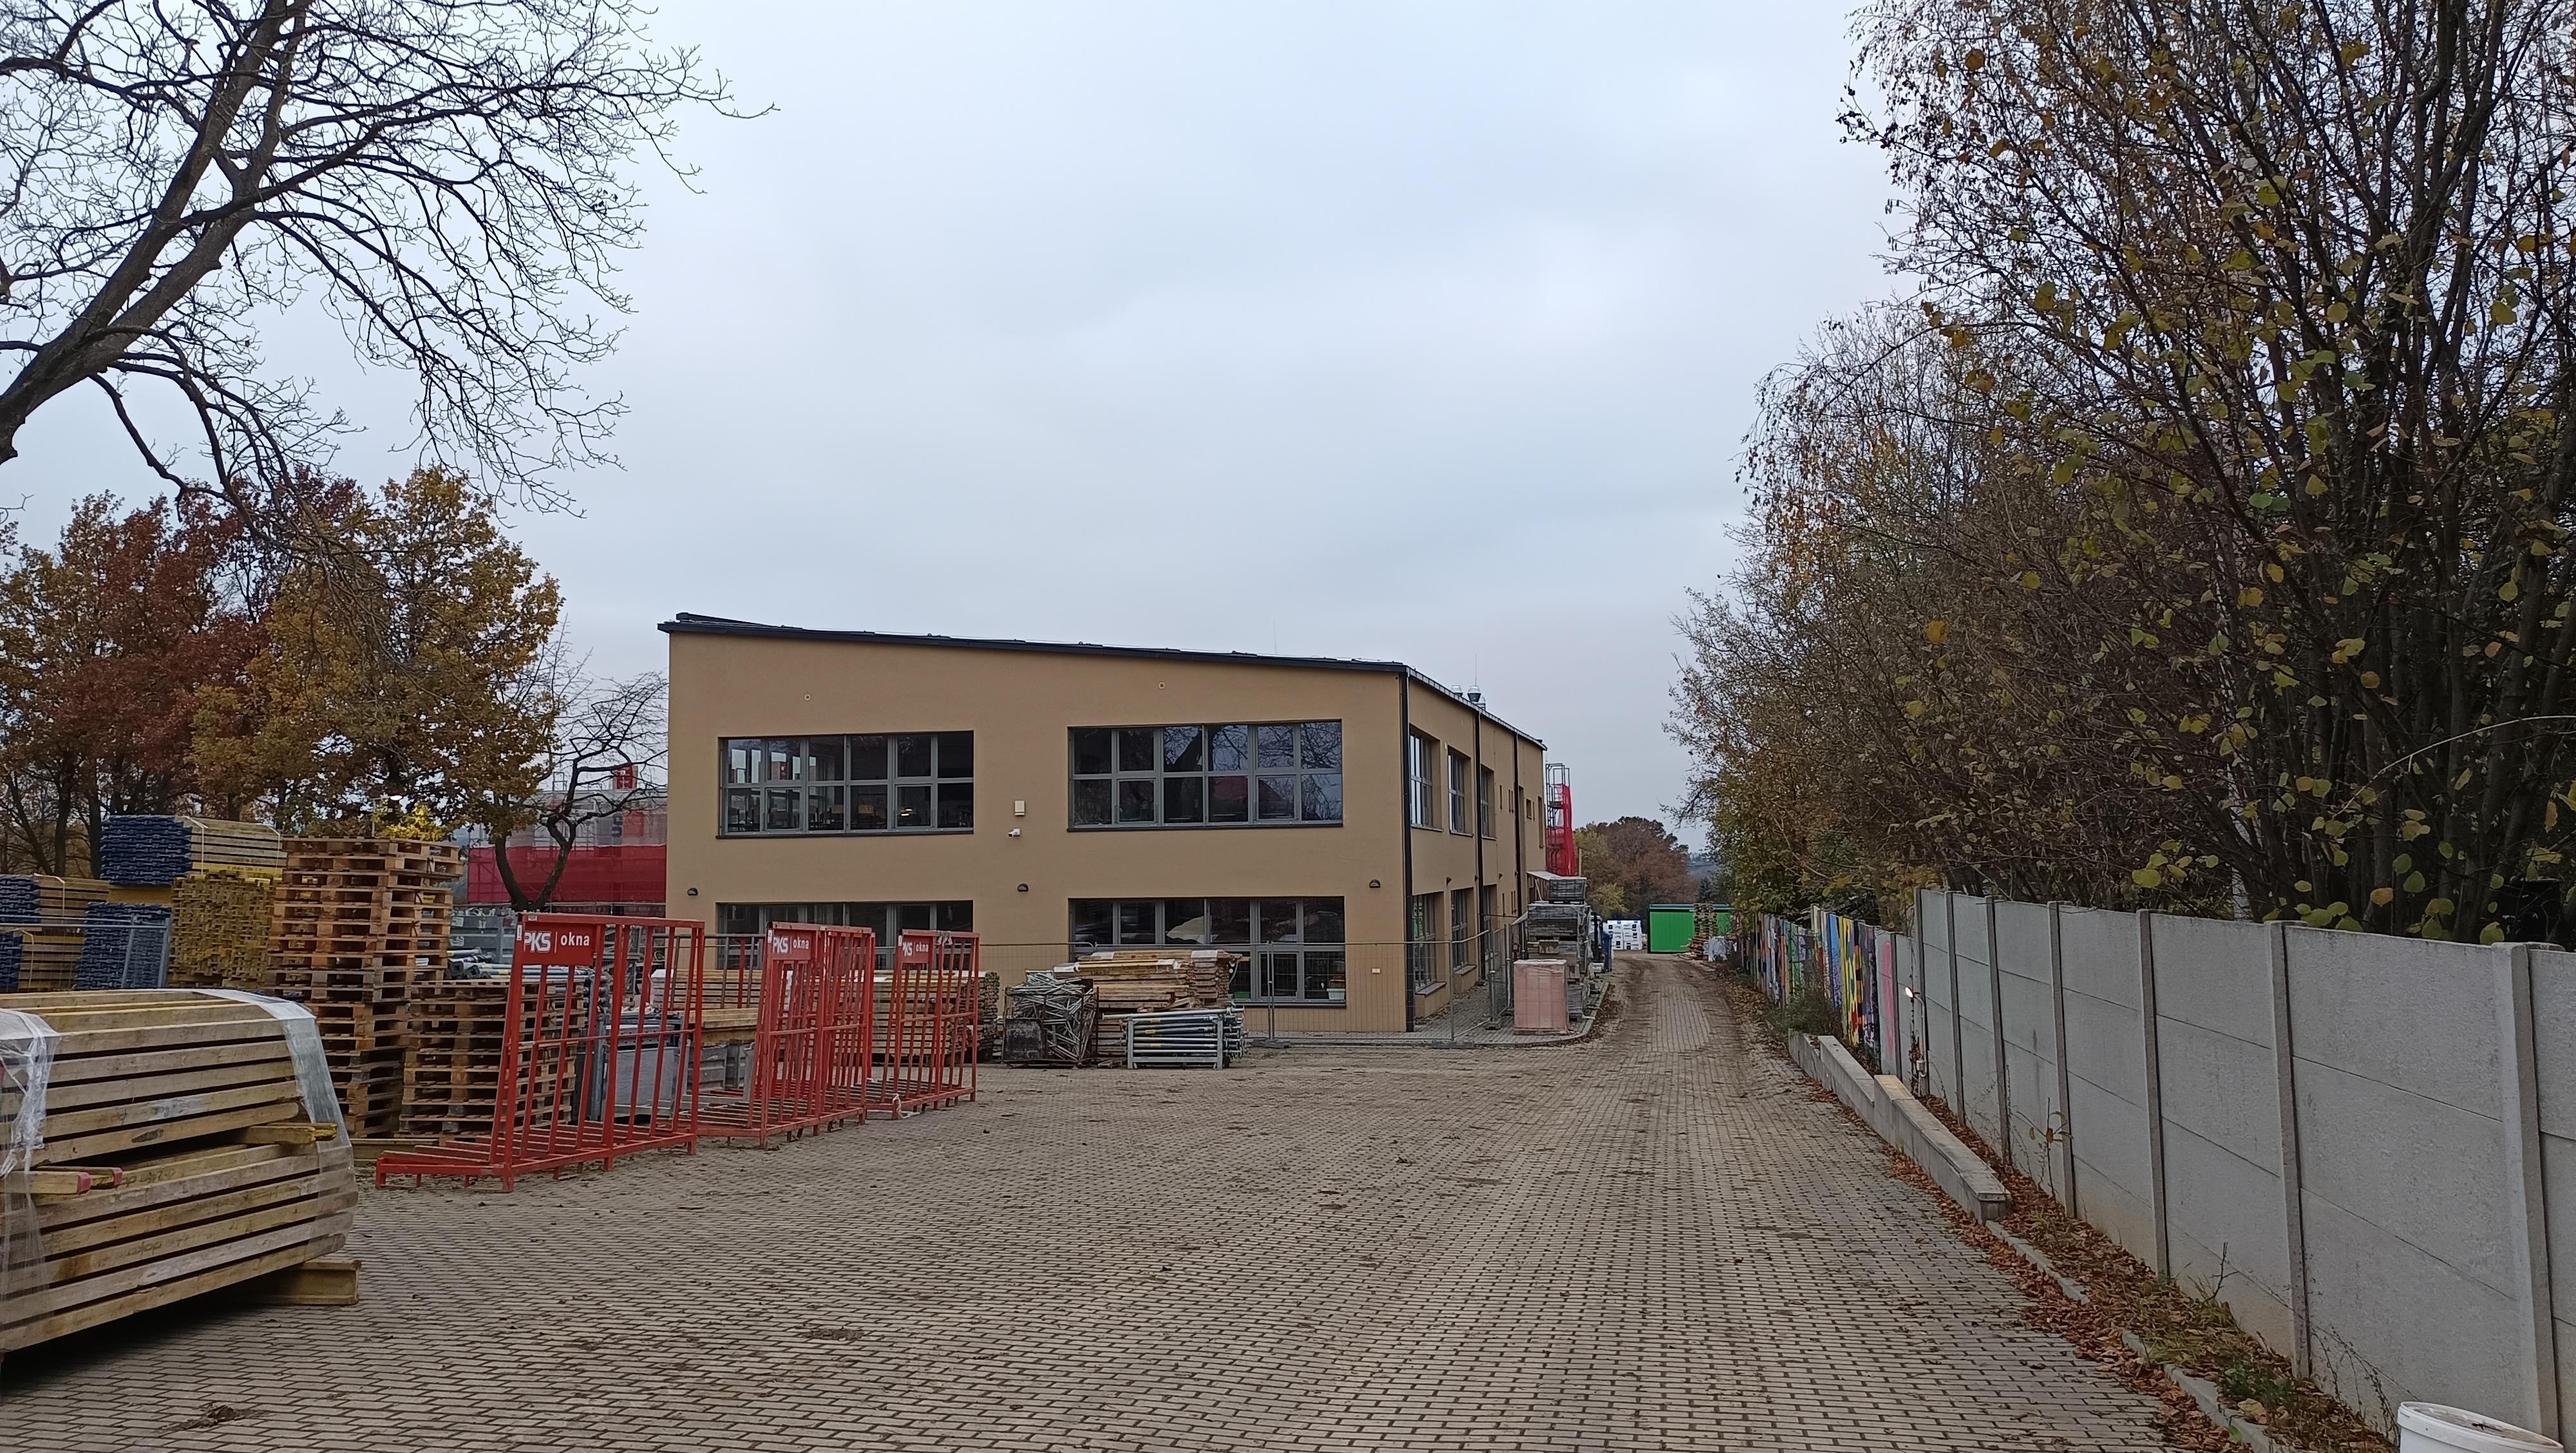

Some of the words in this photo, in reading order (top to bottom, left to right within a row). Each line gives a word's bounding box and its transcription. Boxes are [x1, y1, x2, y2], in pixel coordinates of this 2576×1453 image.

[524, 931, 551, 953] PKS
[560, 931, 590, 946] okna
[773, 936, 789, 954] PKS
[793, 936, 810, 949] okna
[916, 942, 929, 953] okna
